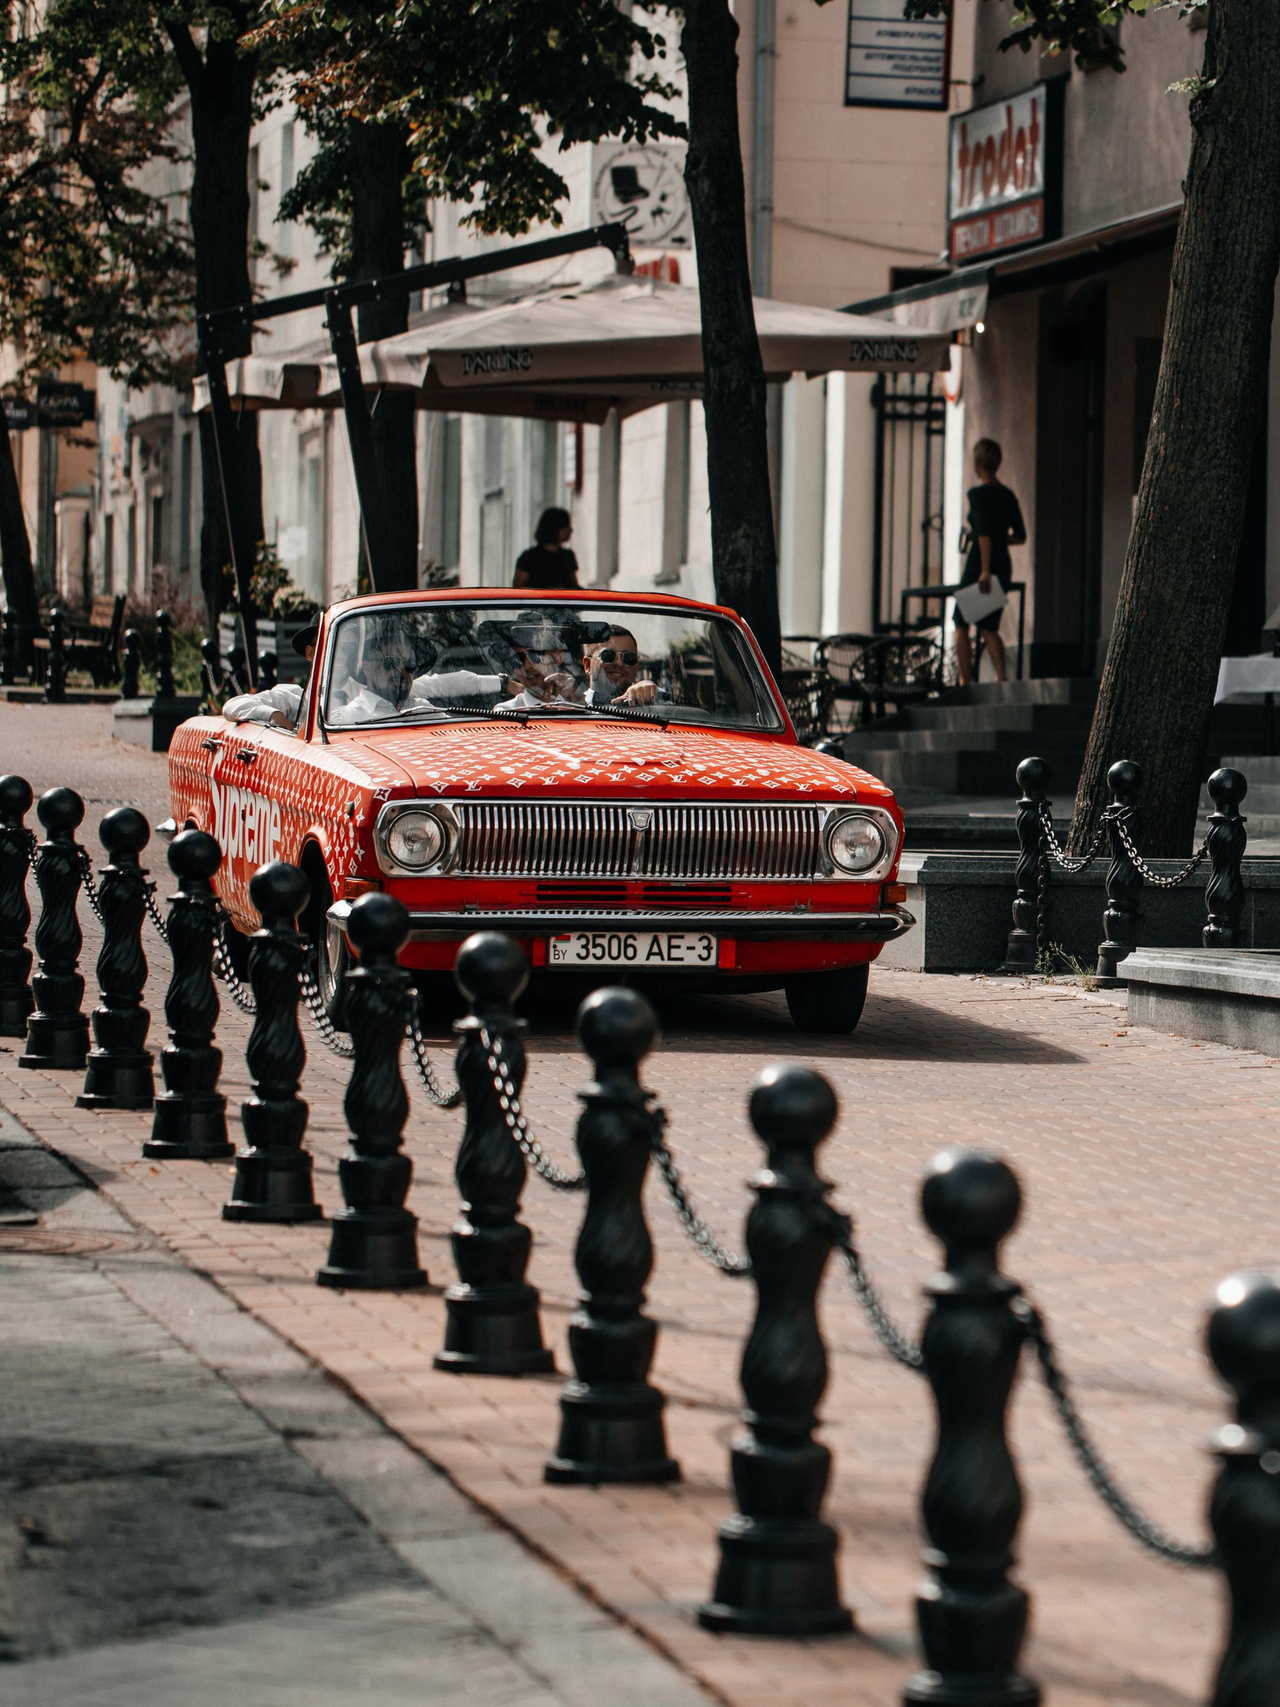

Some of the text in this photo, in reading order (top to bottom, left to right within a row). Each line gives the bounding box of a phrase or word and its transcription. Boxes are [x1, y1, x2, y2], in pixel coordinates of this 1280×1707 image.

[211, 746, 281, 893] Supreme
[553, 950, 567, 960] BY
[576, 934, 713, 962] 3506 AE-3
